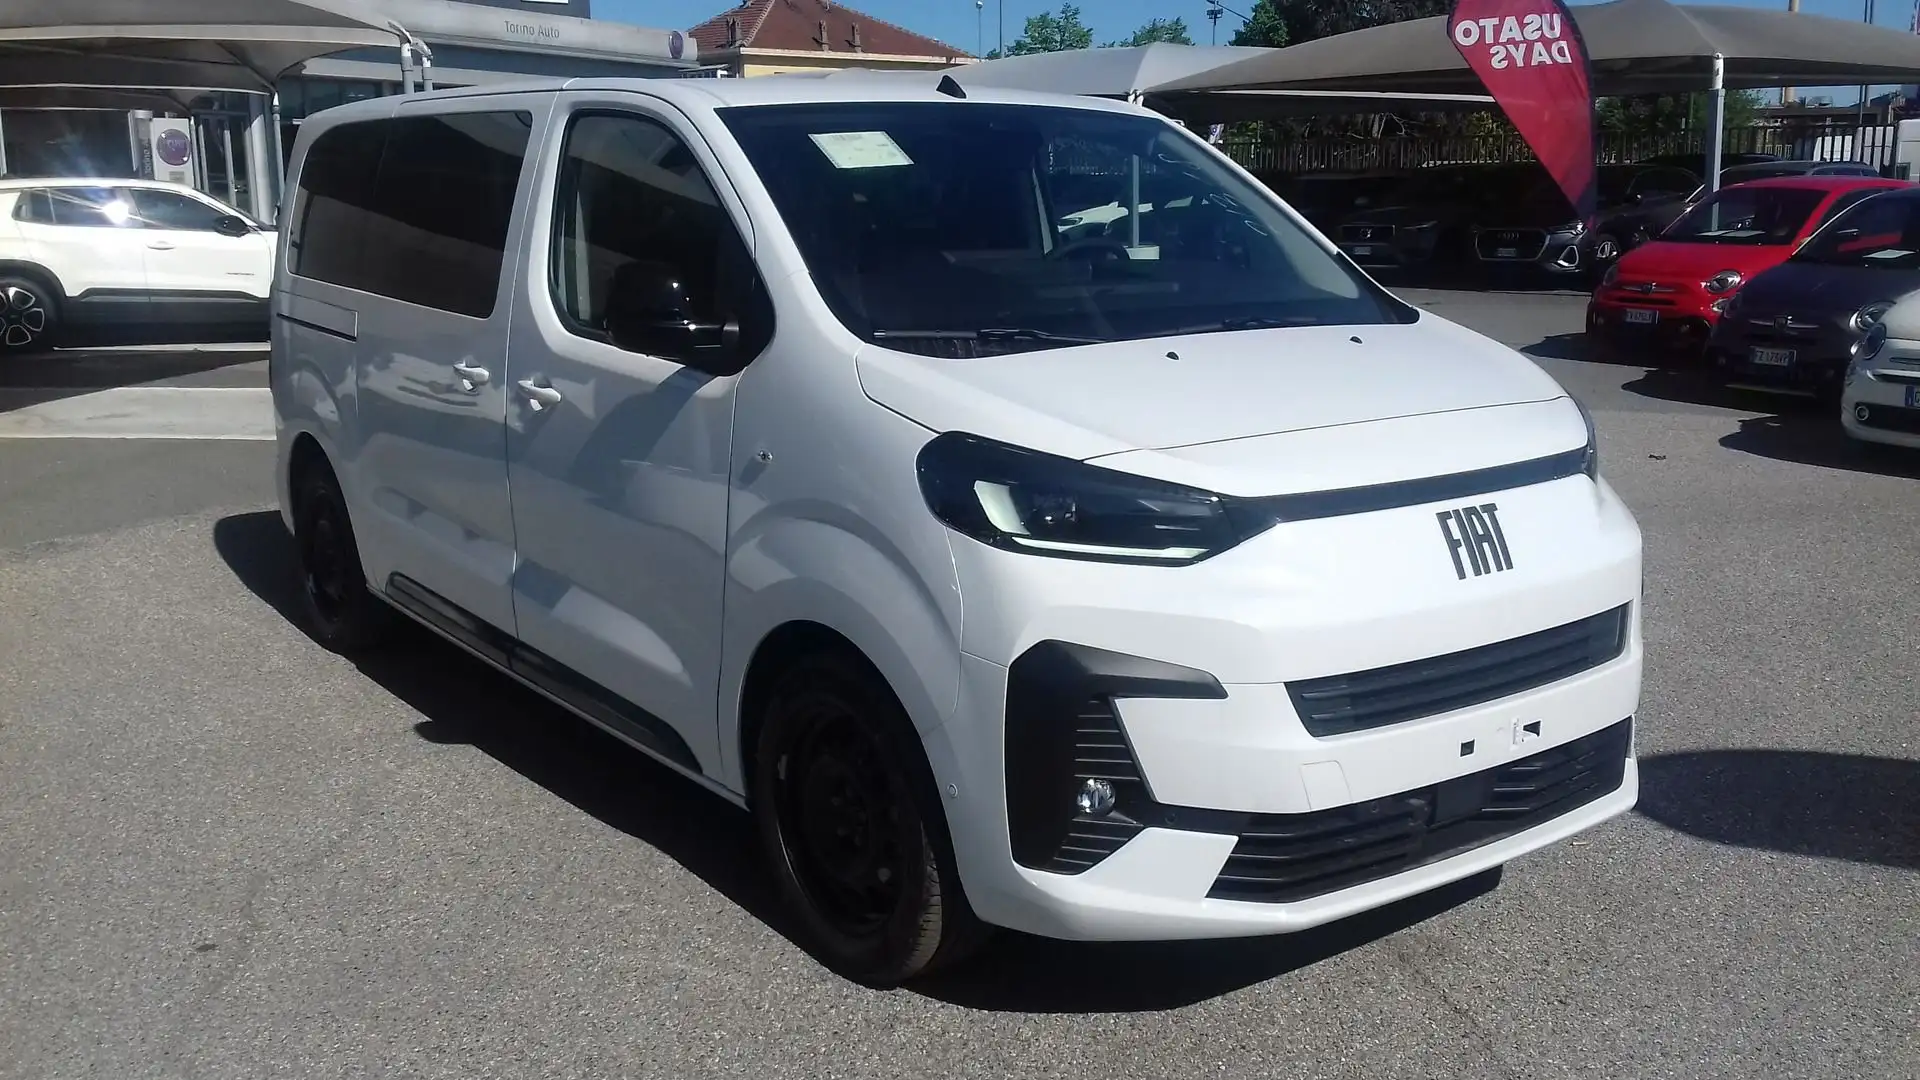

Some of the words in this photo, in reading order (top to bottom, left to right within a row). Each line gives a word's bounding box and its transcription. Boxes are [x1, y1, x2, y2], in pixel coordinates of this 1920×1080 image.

[504, 20, 535, 36] Torino
[537, 25, 560, 38] Auto
[1435, 503, 1514, 580] FIAT
